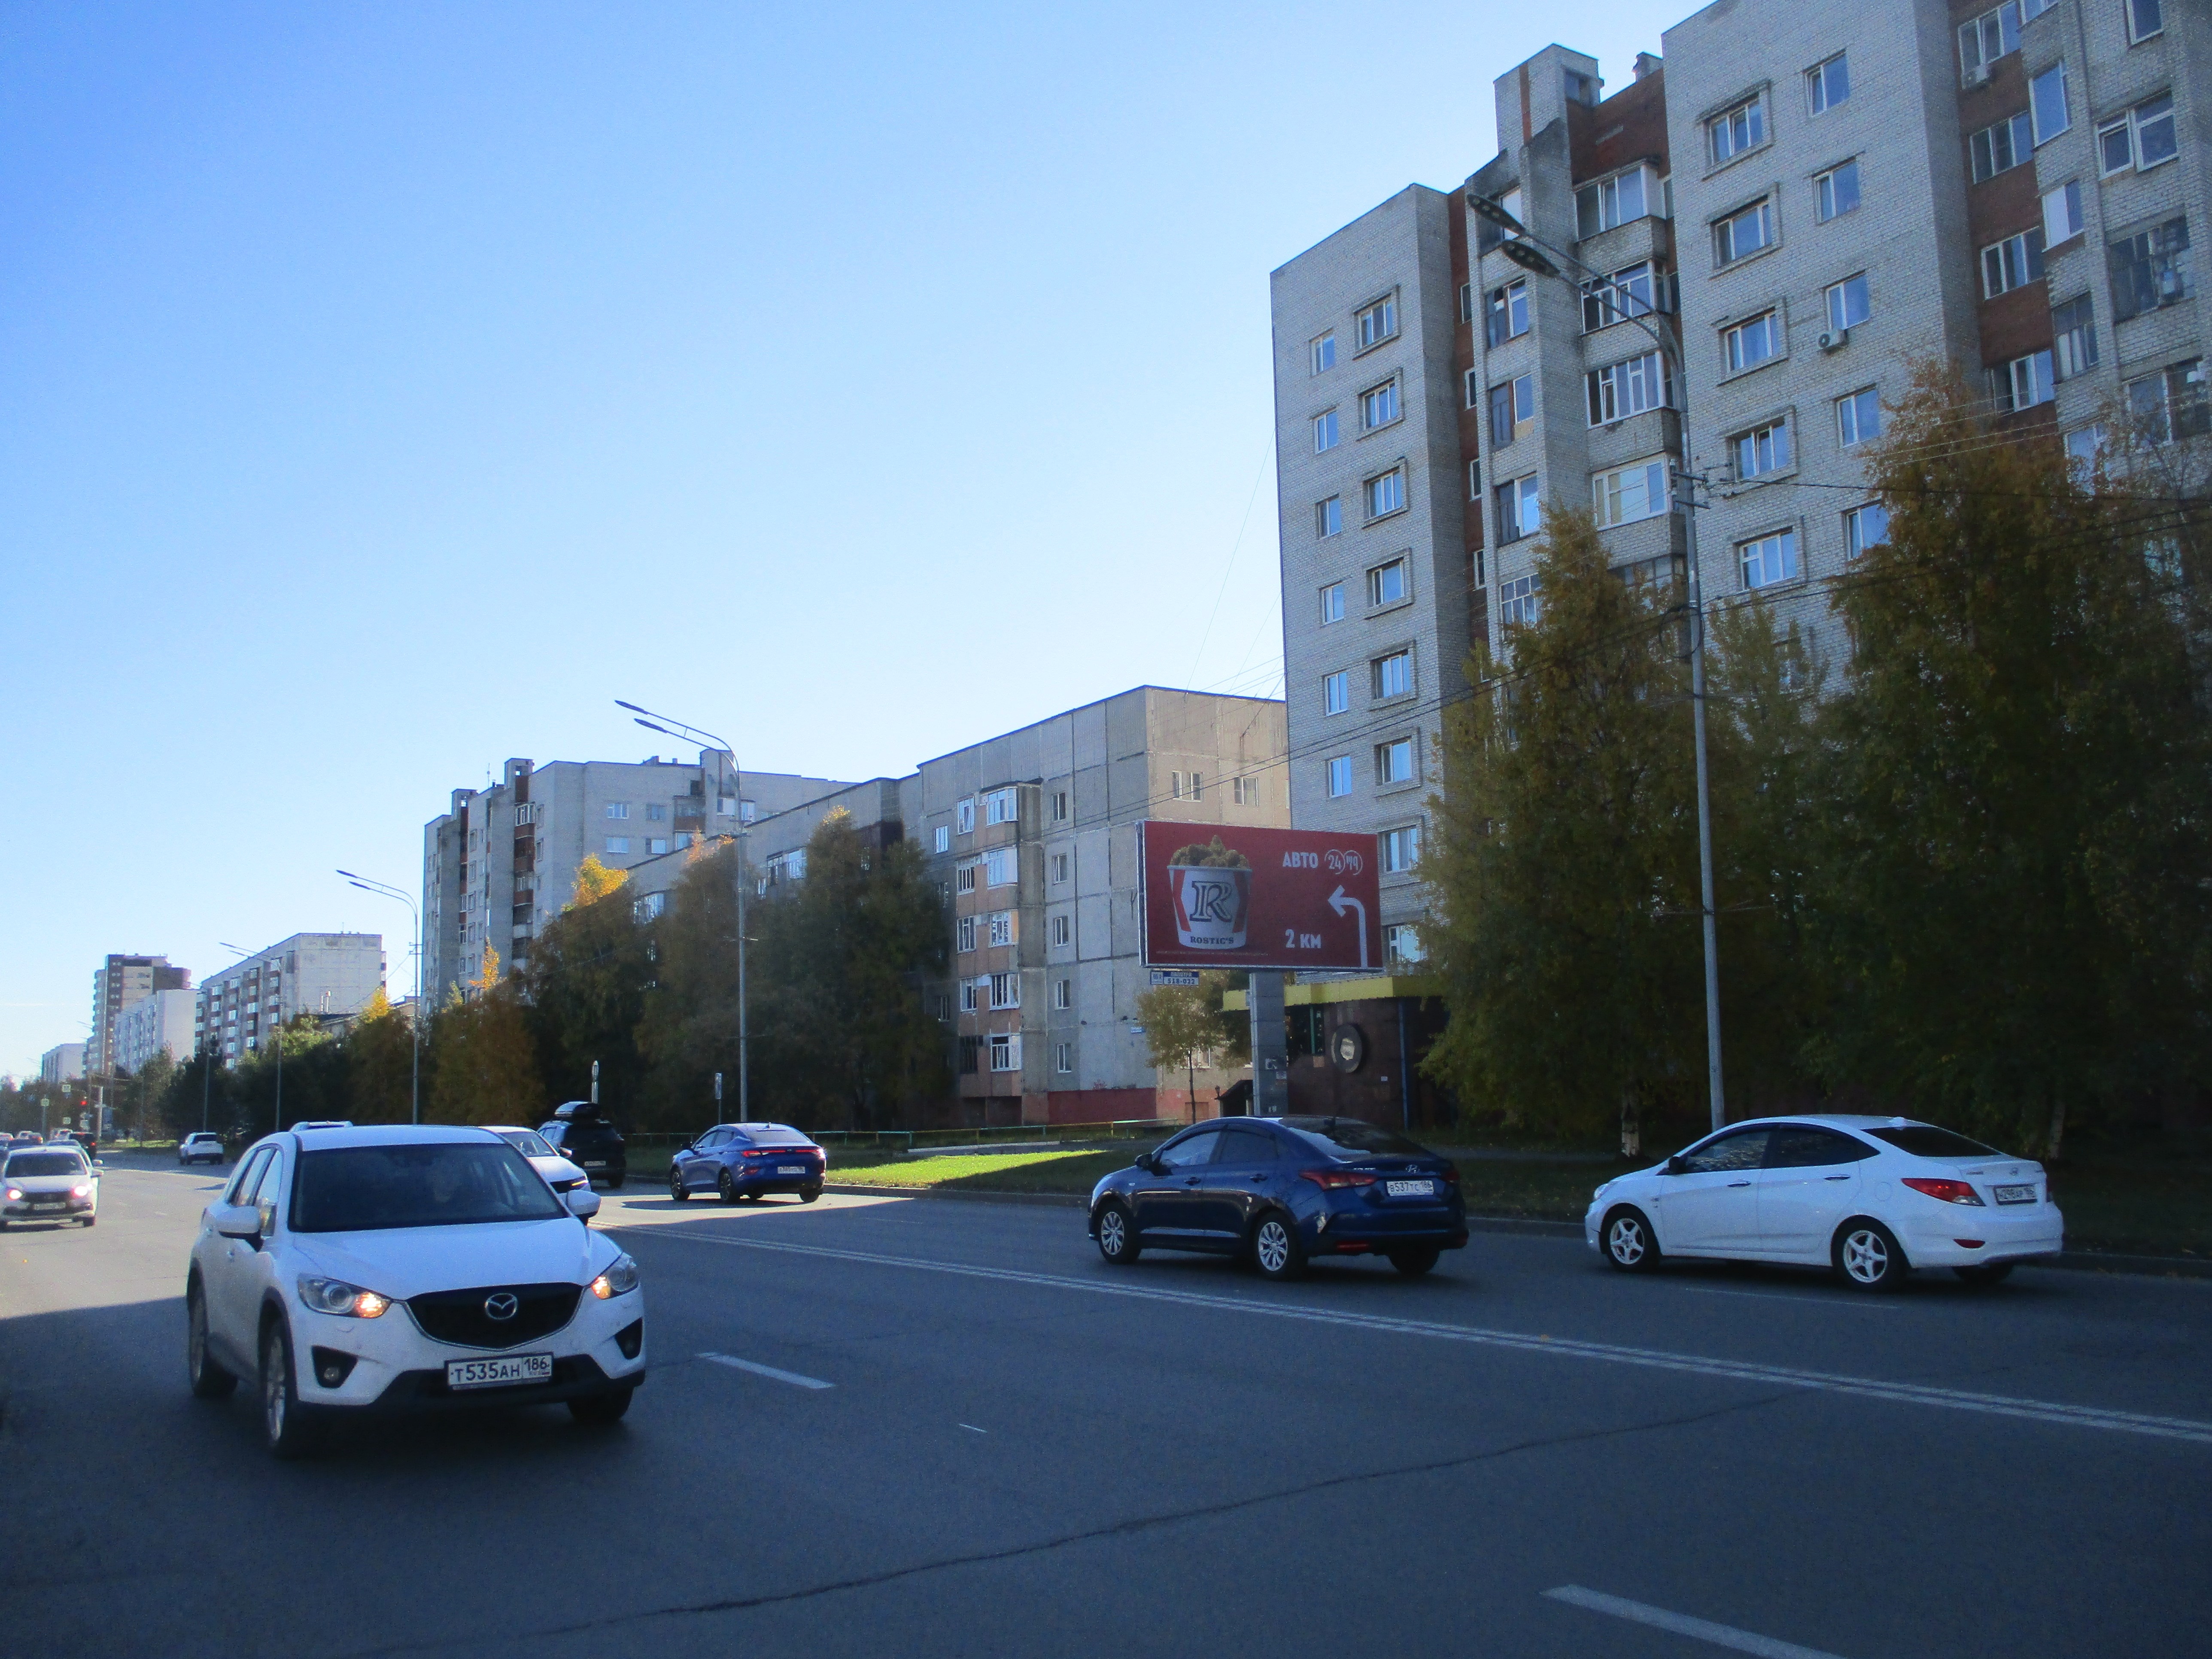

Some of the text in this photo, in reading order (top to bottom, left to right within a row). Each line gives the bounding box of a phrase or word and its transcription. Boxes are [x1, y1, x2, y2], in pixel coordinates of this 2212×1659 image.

[1282, 851, 1319, 869] АВТО
[1189, 881, 1233, 922] R
[1190, 936, 1234, 945] ROSTIC'S
[1285, 929, 1295, 948] 2
[455, 1357, 547, 1382] Т535АН 186
